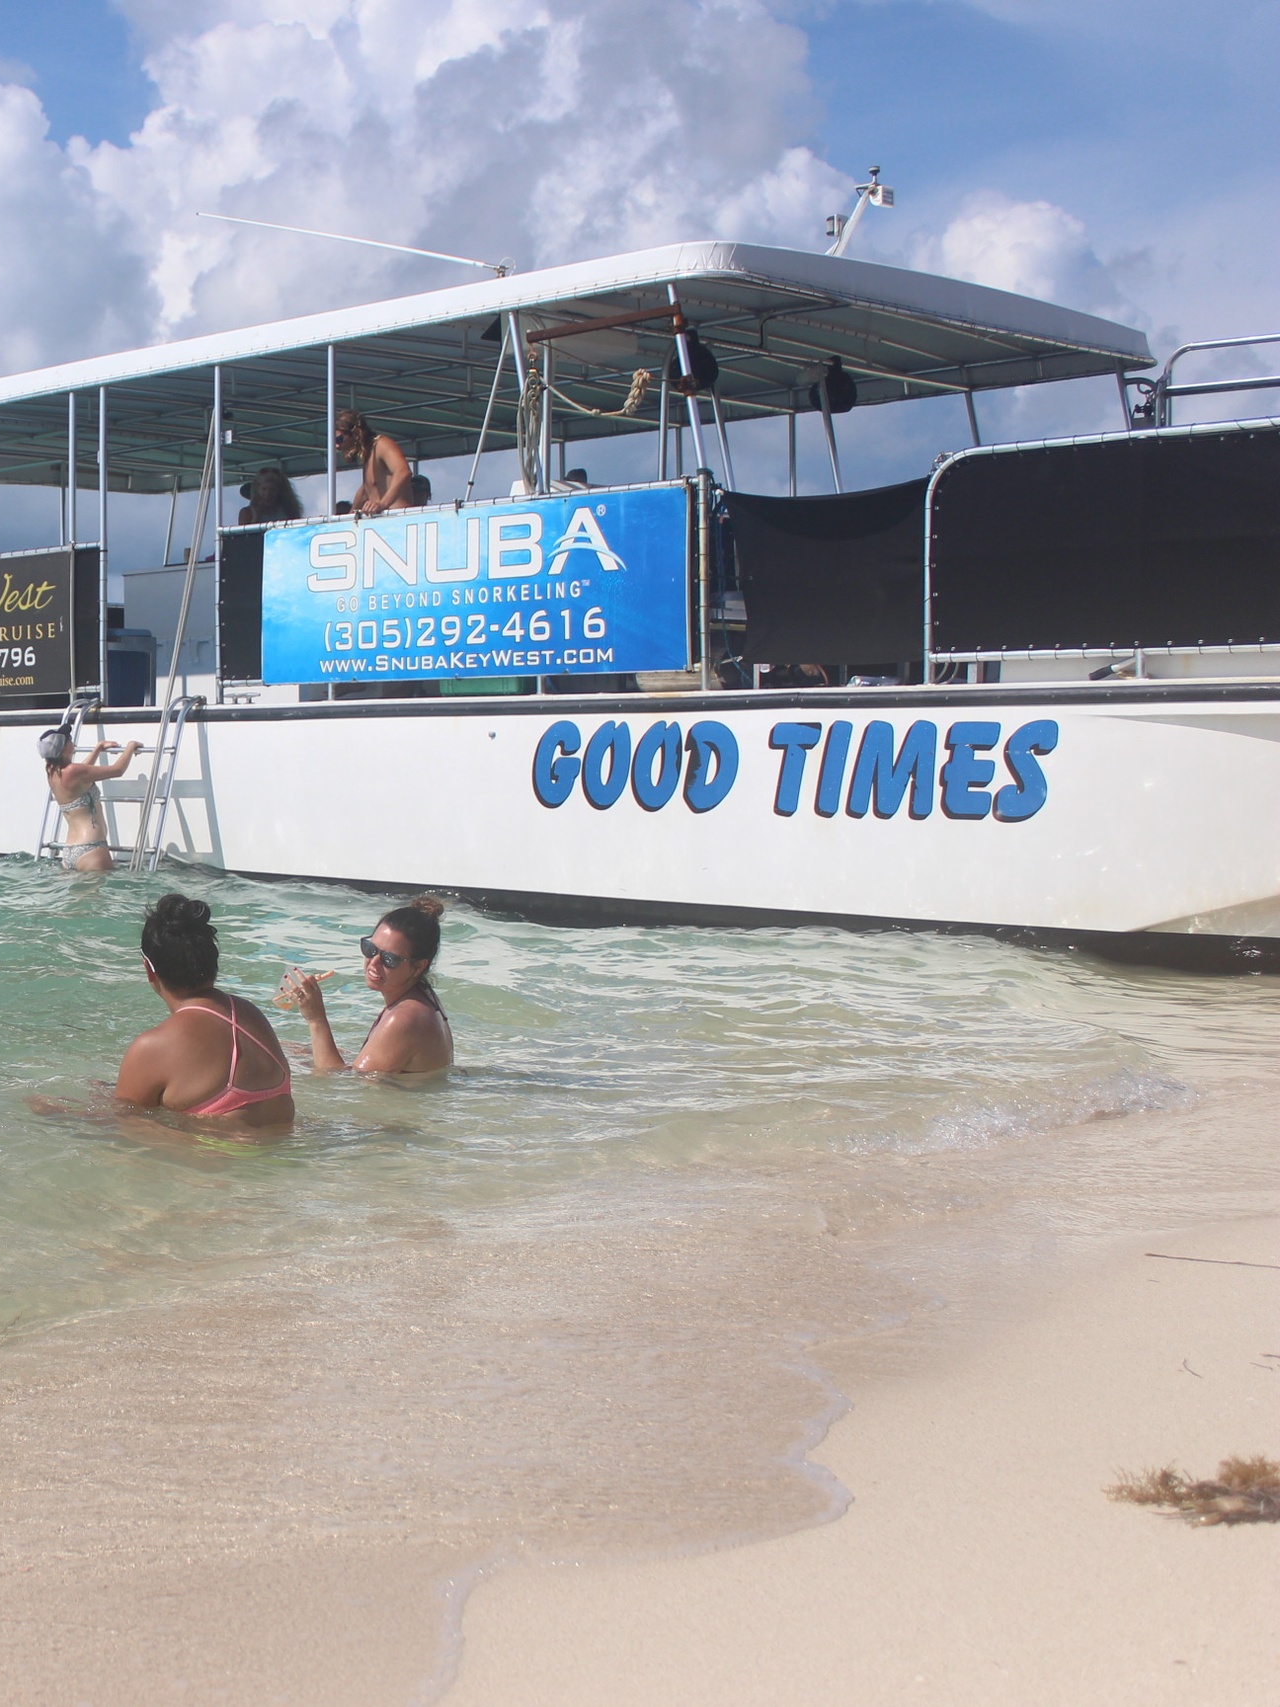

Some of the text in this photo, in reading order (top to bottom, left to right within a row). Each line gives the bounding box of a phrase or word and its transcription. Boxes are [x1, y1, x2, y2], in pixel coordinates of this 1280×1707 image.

[337, 597, 358, 612] GO
[368, 590, 441, 611] BEYOND
[324, 606, 607, 653] (305)292-4616
[532, 719, 1058, 823] GOOD TIMES
